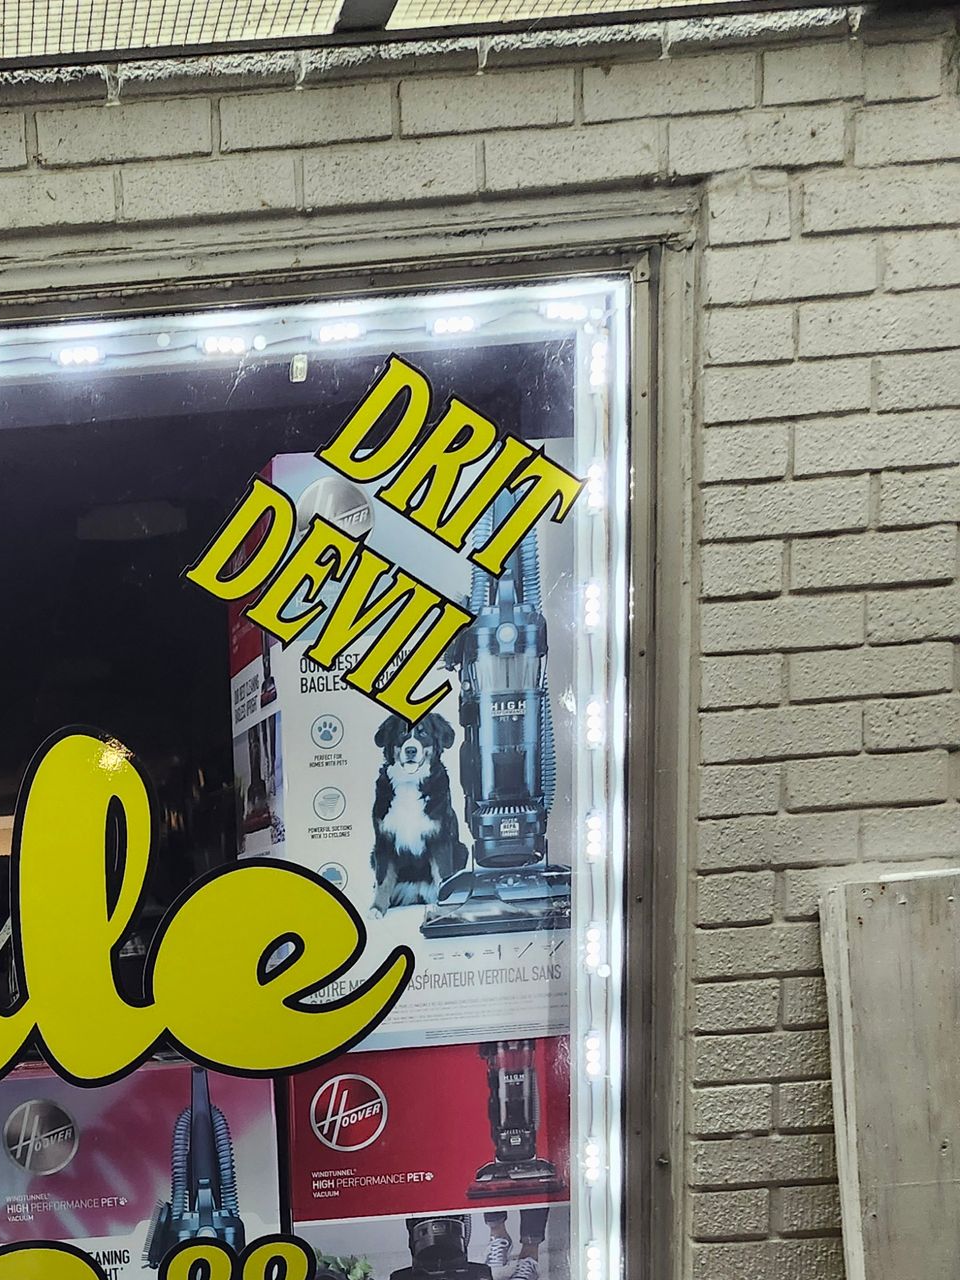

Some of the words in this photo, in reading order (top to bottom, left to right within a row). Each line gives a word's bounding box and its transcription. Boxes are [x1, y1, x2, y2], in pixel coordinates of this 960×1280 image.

[315, 352, 588, 579] DRIT
[180, 473, 477, 731] DEVIL
[490, 700, 526, 711] HIGH
[477, 966, 528, 986] VERTICAL
[532, 964, 561, 982] SANS
[312, 1179, 335, 1189] HIGH
[336, 1173, 405, 1188] PERFORMANCE
[407, 1172, 425, 1182] PET
[312, 1190, 339, 1198] VACUUM
[7, 1204, 29, 1214] HIGH
[30, 1198, 99, 1212] PERFORMANCE
[101, 1197, 118, 1207] PET
